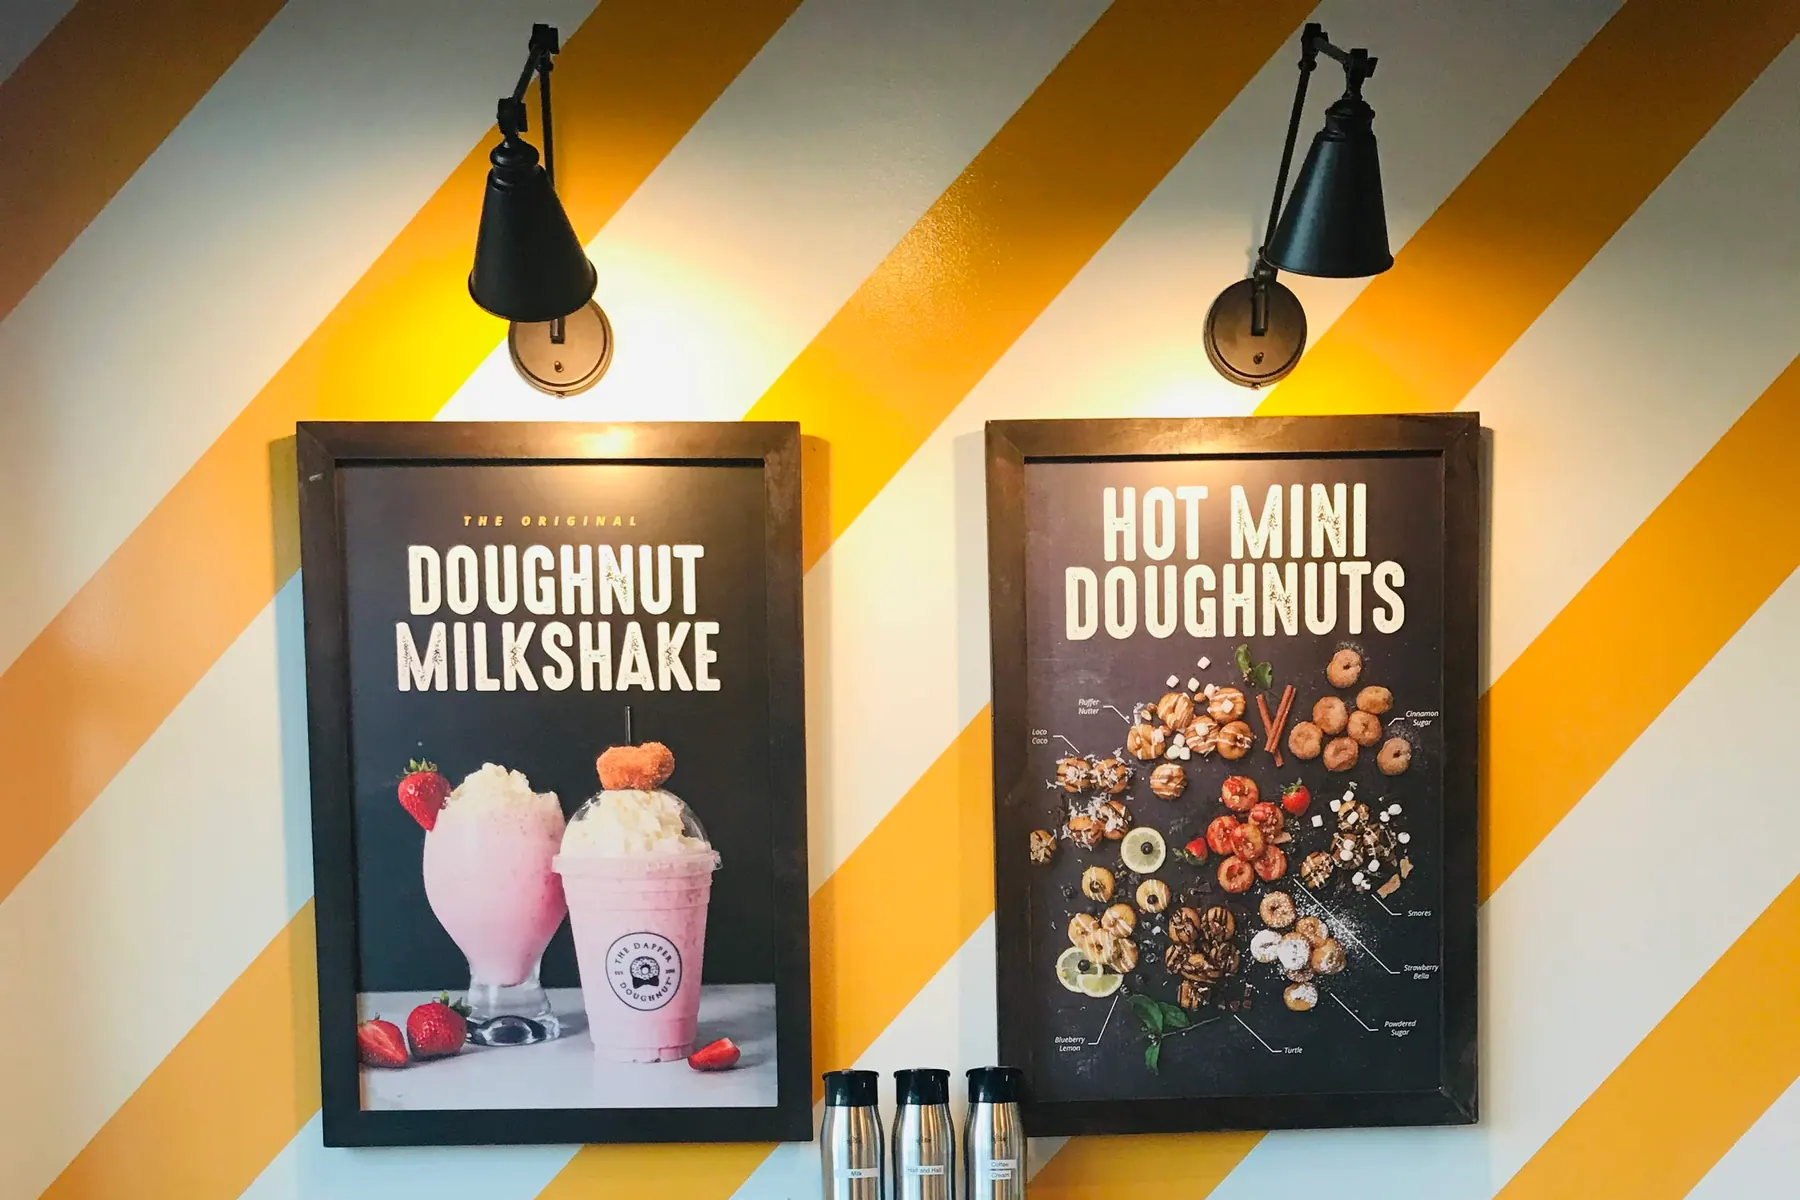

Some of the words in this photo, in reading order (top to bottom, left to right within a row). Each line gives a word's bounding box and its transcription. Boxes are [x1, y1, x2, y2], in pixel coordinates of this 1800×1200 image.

[463, 516, 504, 527] THE
[521, 515, 638, 527] ORIGINAL
[1103, 485, 1208, 561] HOT
[1230, 483, 1367, 559] MINI
[408, 544, 705, 616] DOUGHNUT
[1065, 560, 1405, 640] DOUGHNUTS
[395, 621, 721, 692] MILKSHAKE
[1078, 698, 1100, 707] Fluffer
[1405, 710, 1439, 718] Cinnamon
[1412, 719, 1432, 728] Sugar
[1031, 728, 1048, 736] Loco
[1031, 737, 1049, 745] Coco
[1407, 909, 1432, 917] Smores
[614, 947, 630, 964] THE
[633, 942, 672, 964] DAPPER
[1404, 964, 1439, 973] Strawberry
[1413, 972, 1430, 980] Bella
[620, 977, 672, 1002] DOUGHNUT
[1384, 1019, 1417, 1028] Powdered
[1390, 1029, 1410, 1038] Sugar
[1054, 1036, 1086, 1045] Blueberry
[1283, 1046, 1303, 1054] Turtle
[991, 1171, 1010, 1179] Cream
